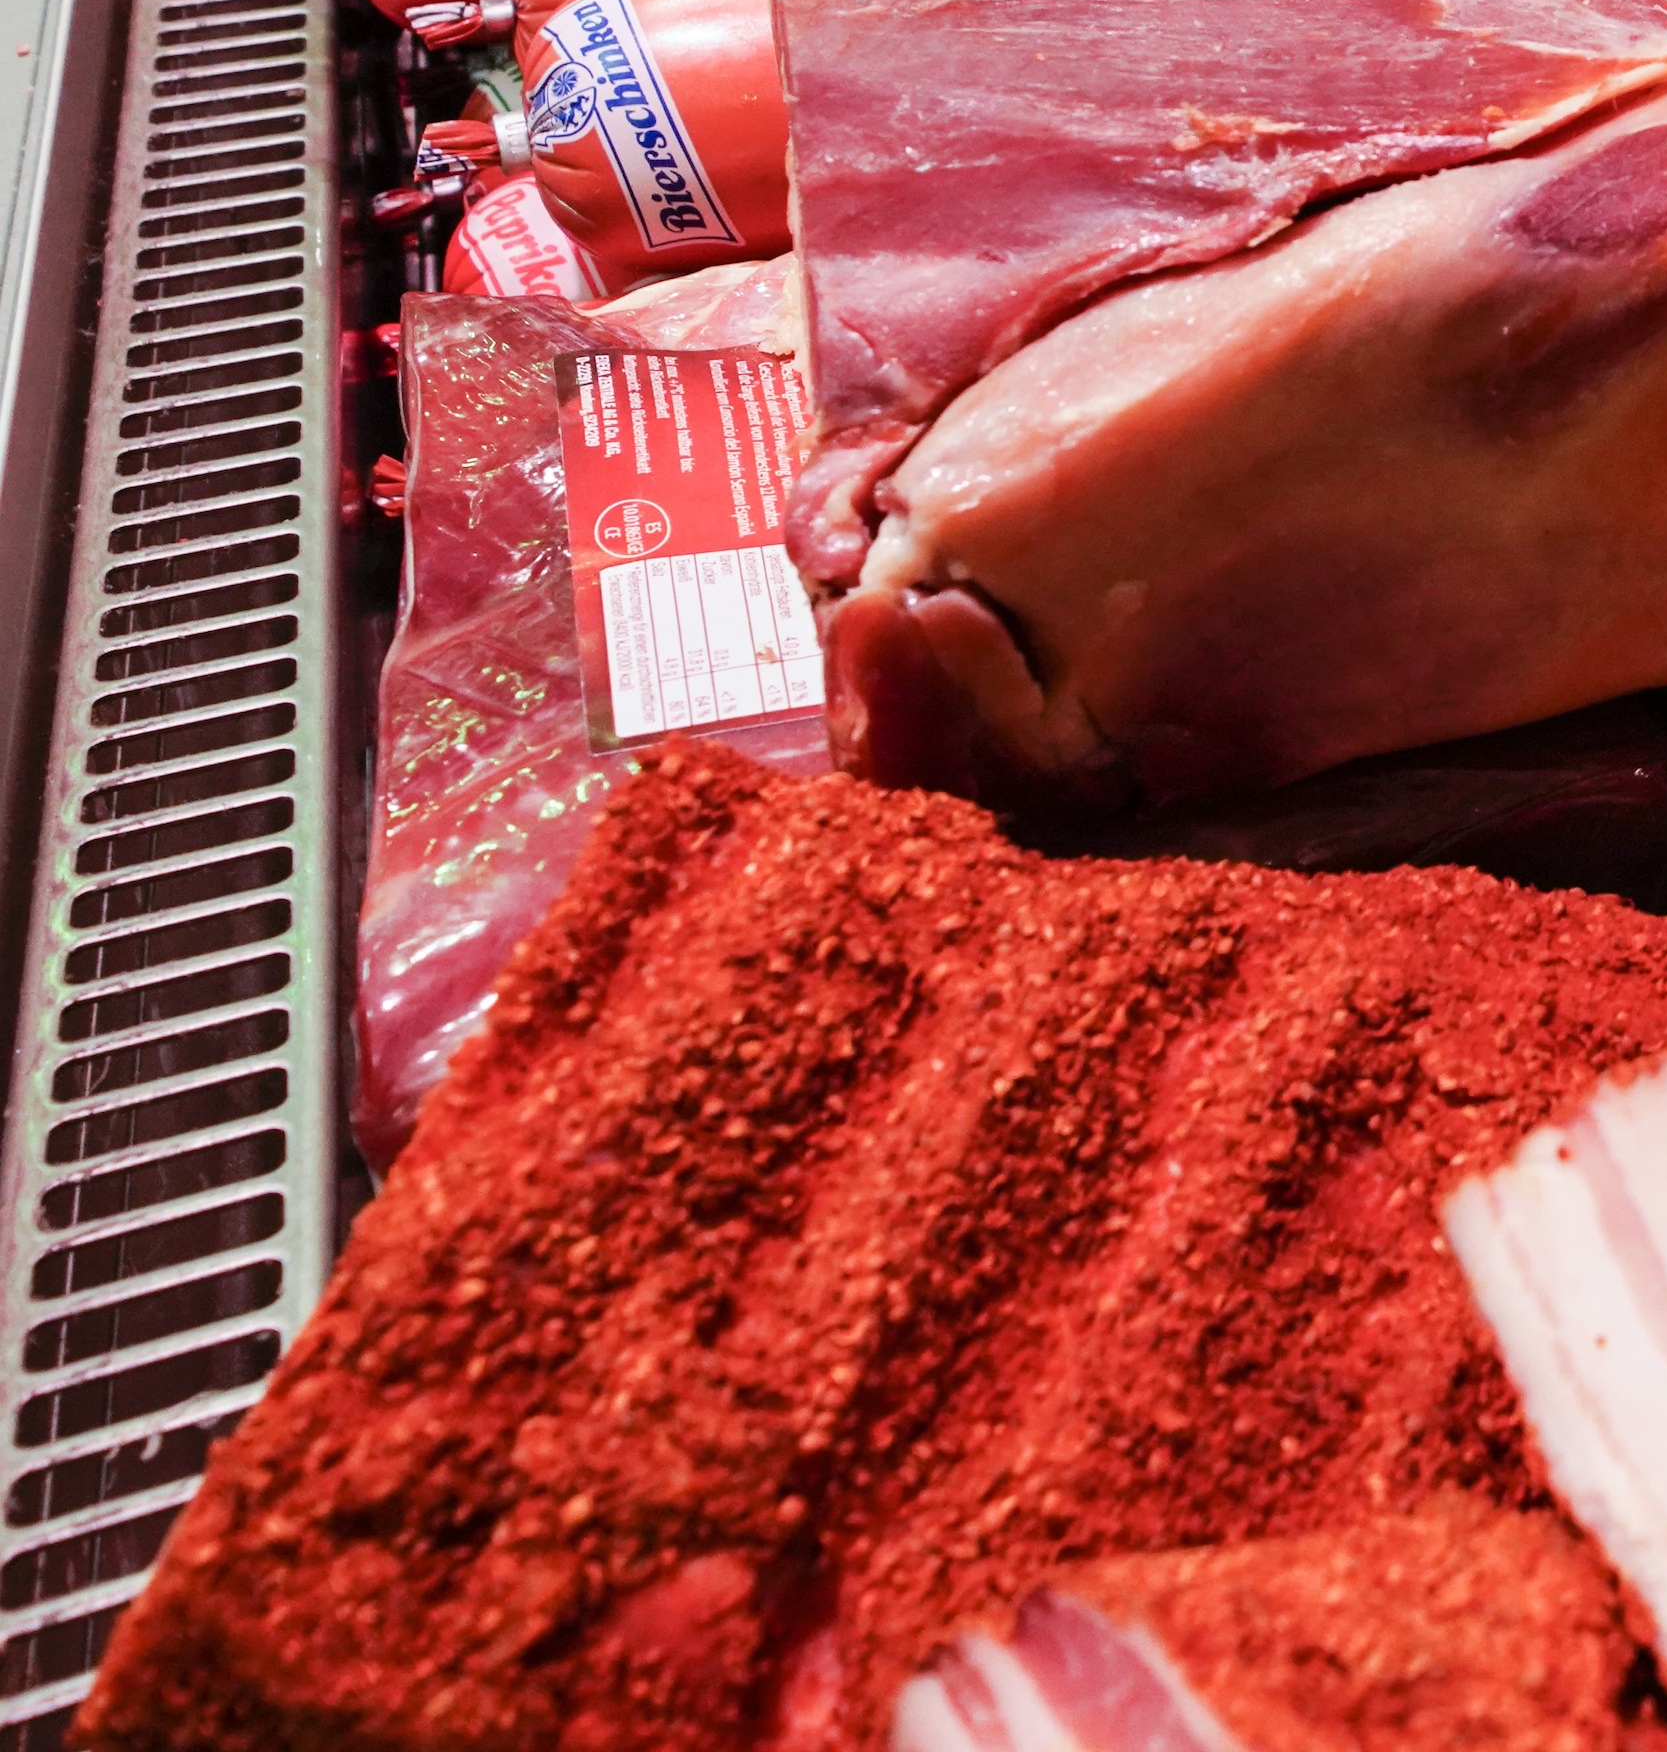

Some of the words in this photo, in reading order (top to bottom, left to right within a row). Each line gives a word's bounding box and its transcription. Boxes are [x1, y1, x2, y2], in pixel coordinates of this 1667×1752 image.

[573, 0, 707, 233] Bierschinken
[595, 355, 612, 376] EDEKA
[598, 376, 616, 408] ZENTRALE
[602, 409, 618, 419] AG
[718, 404, 739, 438] Consorcio
[604, 427, 619, 440] Co.
[724, 437, 743, 450] del
[750, 426, 764, 440] von
[604, 442, 621, 458] KG,
[772, 427, 794, 477] Verwedung
[725, 450, 745, 478] Jamón
[752, 441, 771, 486] mindestens
[730, 478, 746, 505] Serrano
[759, 486, 775, 495] 12
[730, 505, 756, 538] Español.
[763, 495, 781, 530] Monaten.
[604, 526, 621, 539] CE
[644, 521, 662, 534] ES
